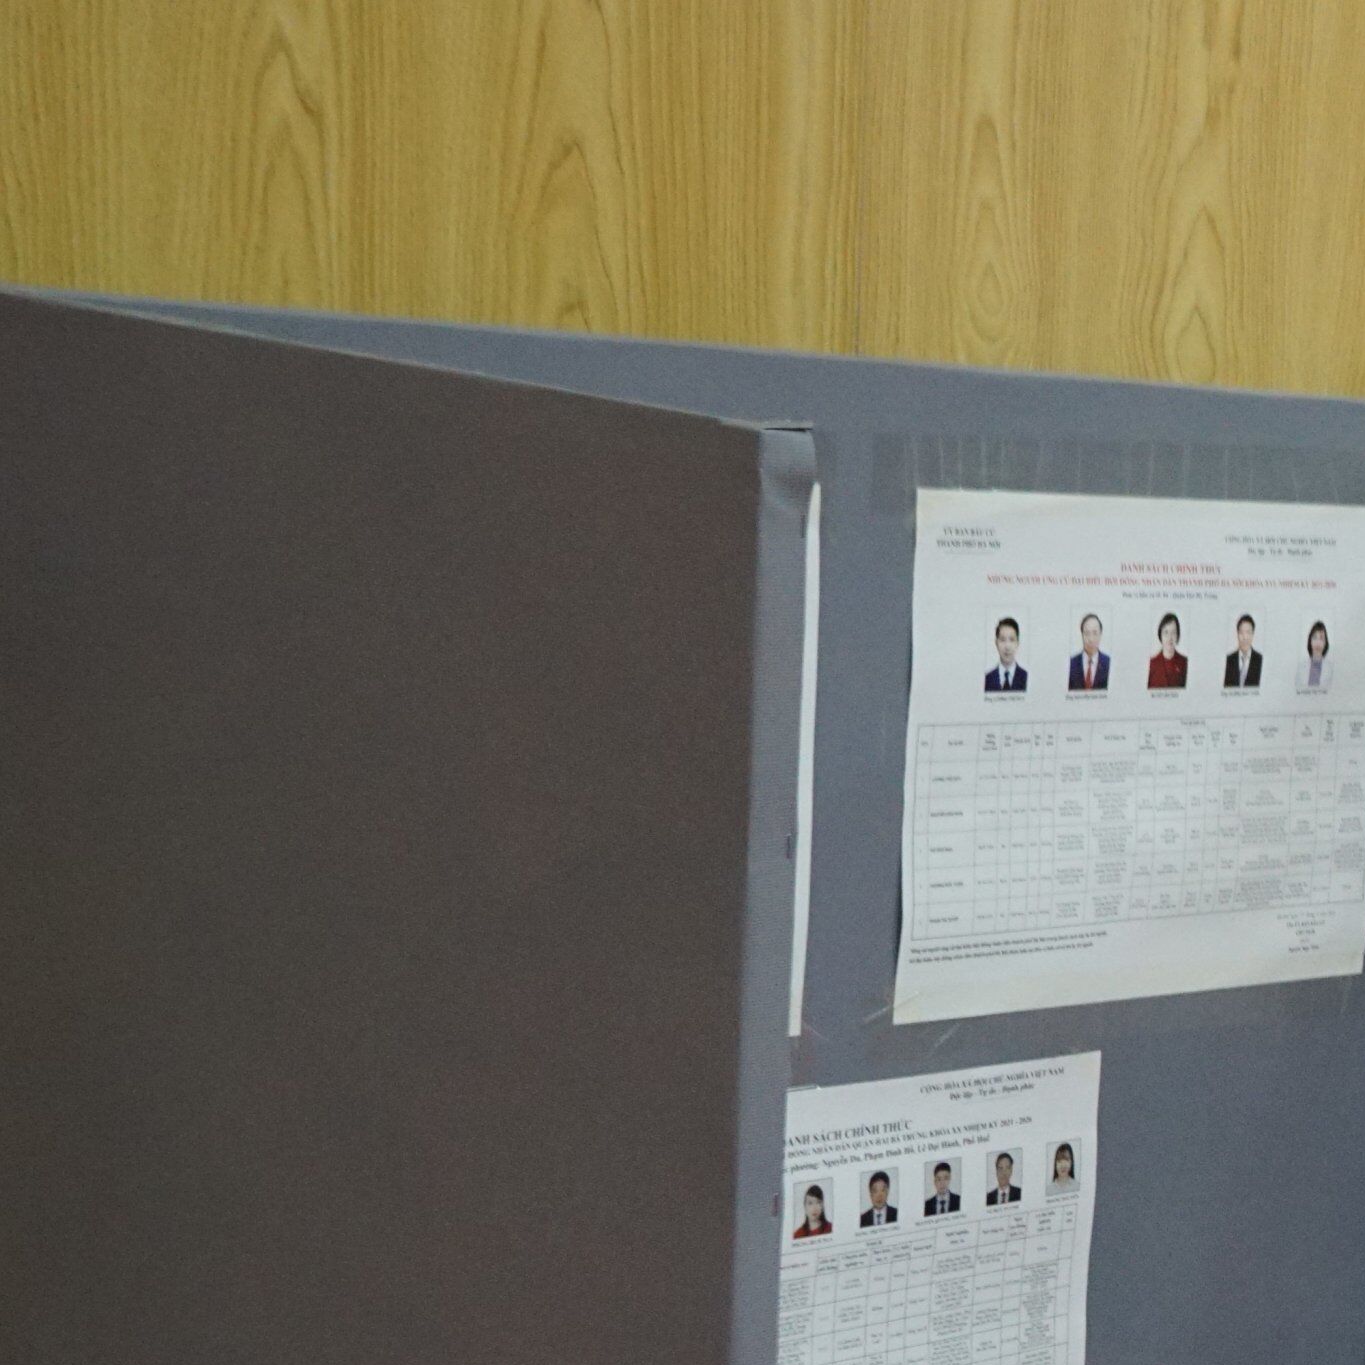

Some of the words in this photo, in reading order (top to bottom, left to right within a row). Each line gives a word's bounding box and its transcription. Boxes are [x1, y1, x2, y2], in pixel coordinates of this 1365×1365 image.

[787, 1135, 810, 1147] ANH
[813, 1129, 842, 1143] SÁCH
[845, 1124, 880, 1138] CHÍNH
[883, 1119, 912, 1132] THỨC
